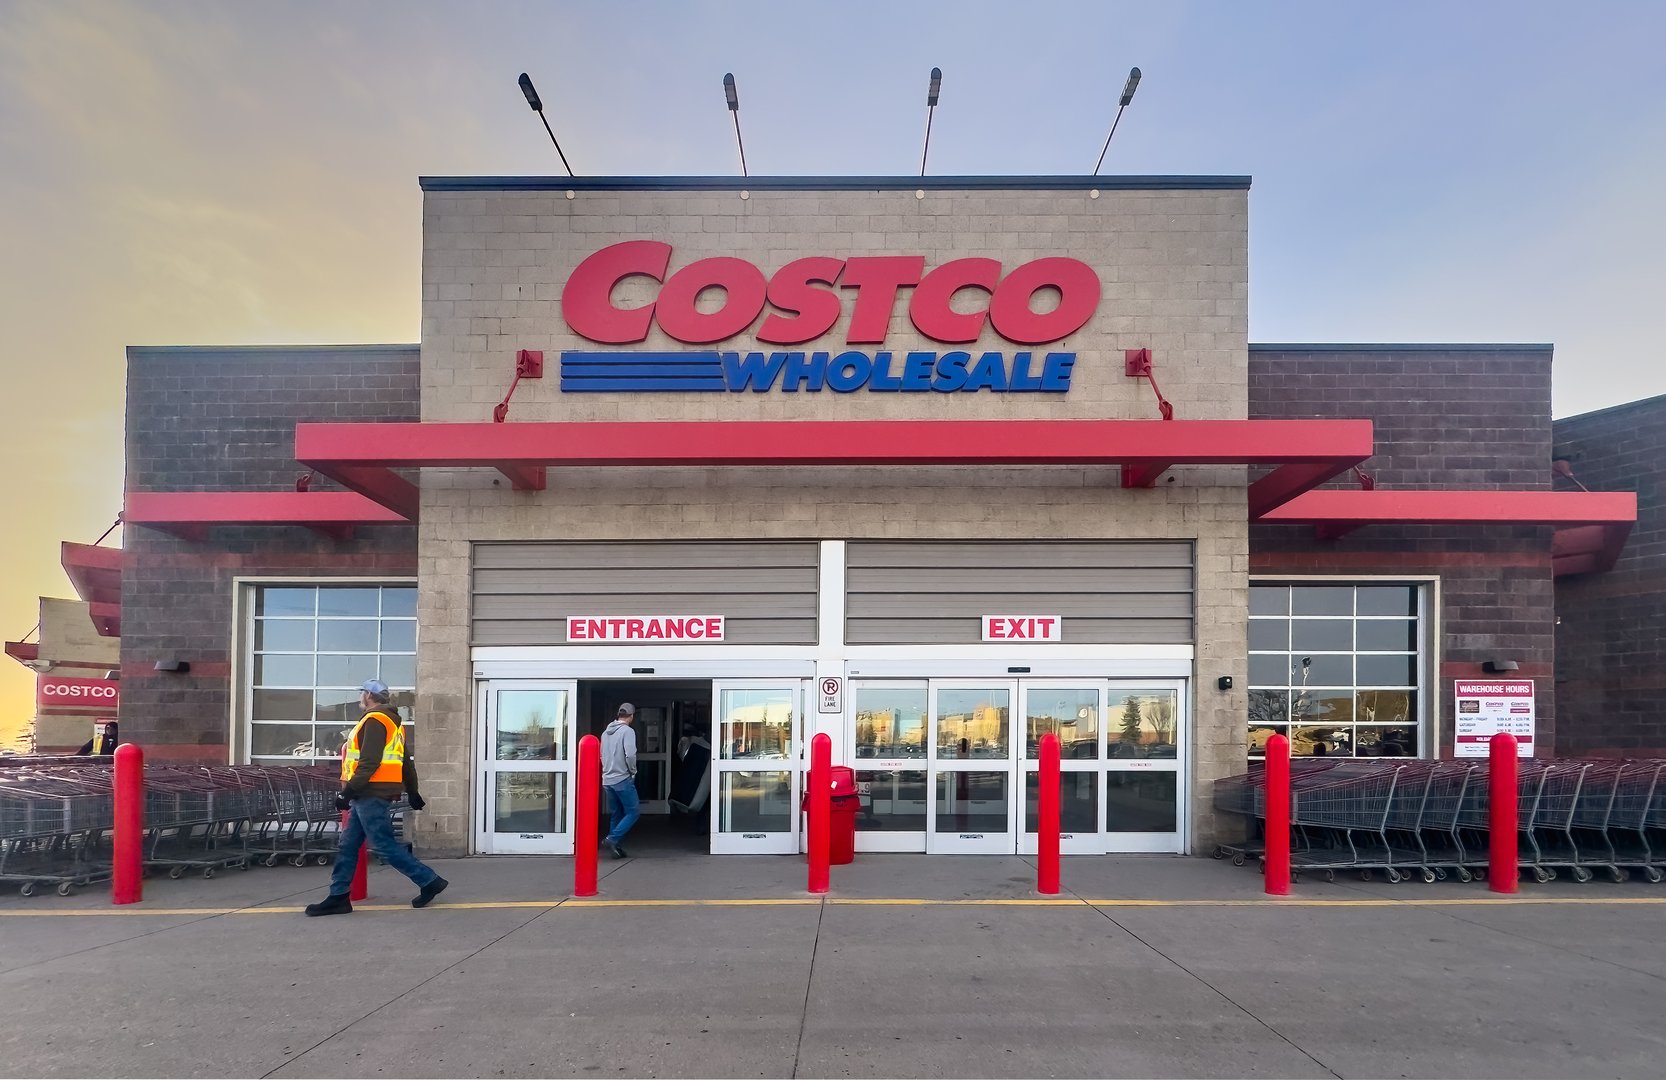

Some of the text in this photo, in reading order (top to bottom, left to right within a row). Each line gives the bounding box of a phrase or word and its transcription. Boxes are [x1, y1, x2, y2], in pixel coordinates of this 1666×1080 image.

[562, 240, 1101, 345] COSTCO
[721, 352, 1077, 393] WHOLESALE
[569, 618, 723, 639] ENTRANCE
[988, 618, 1056, 639] EXIT
[43, 684, 116, 698] COSTCO
[1459, 685, 1530, 693] WAREHOUSE HOURS
